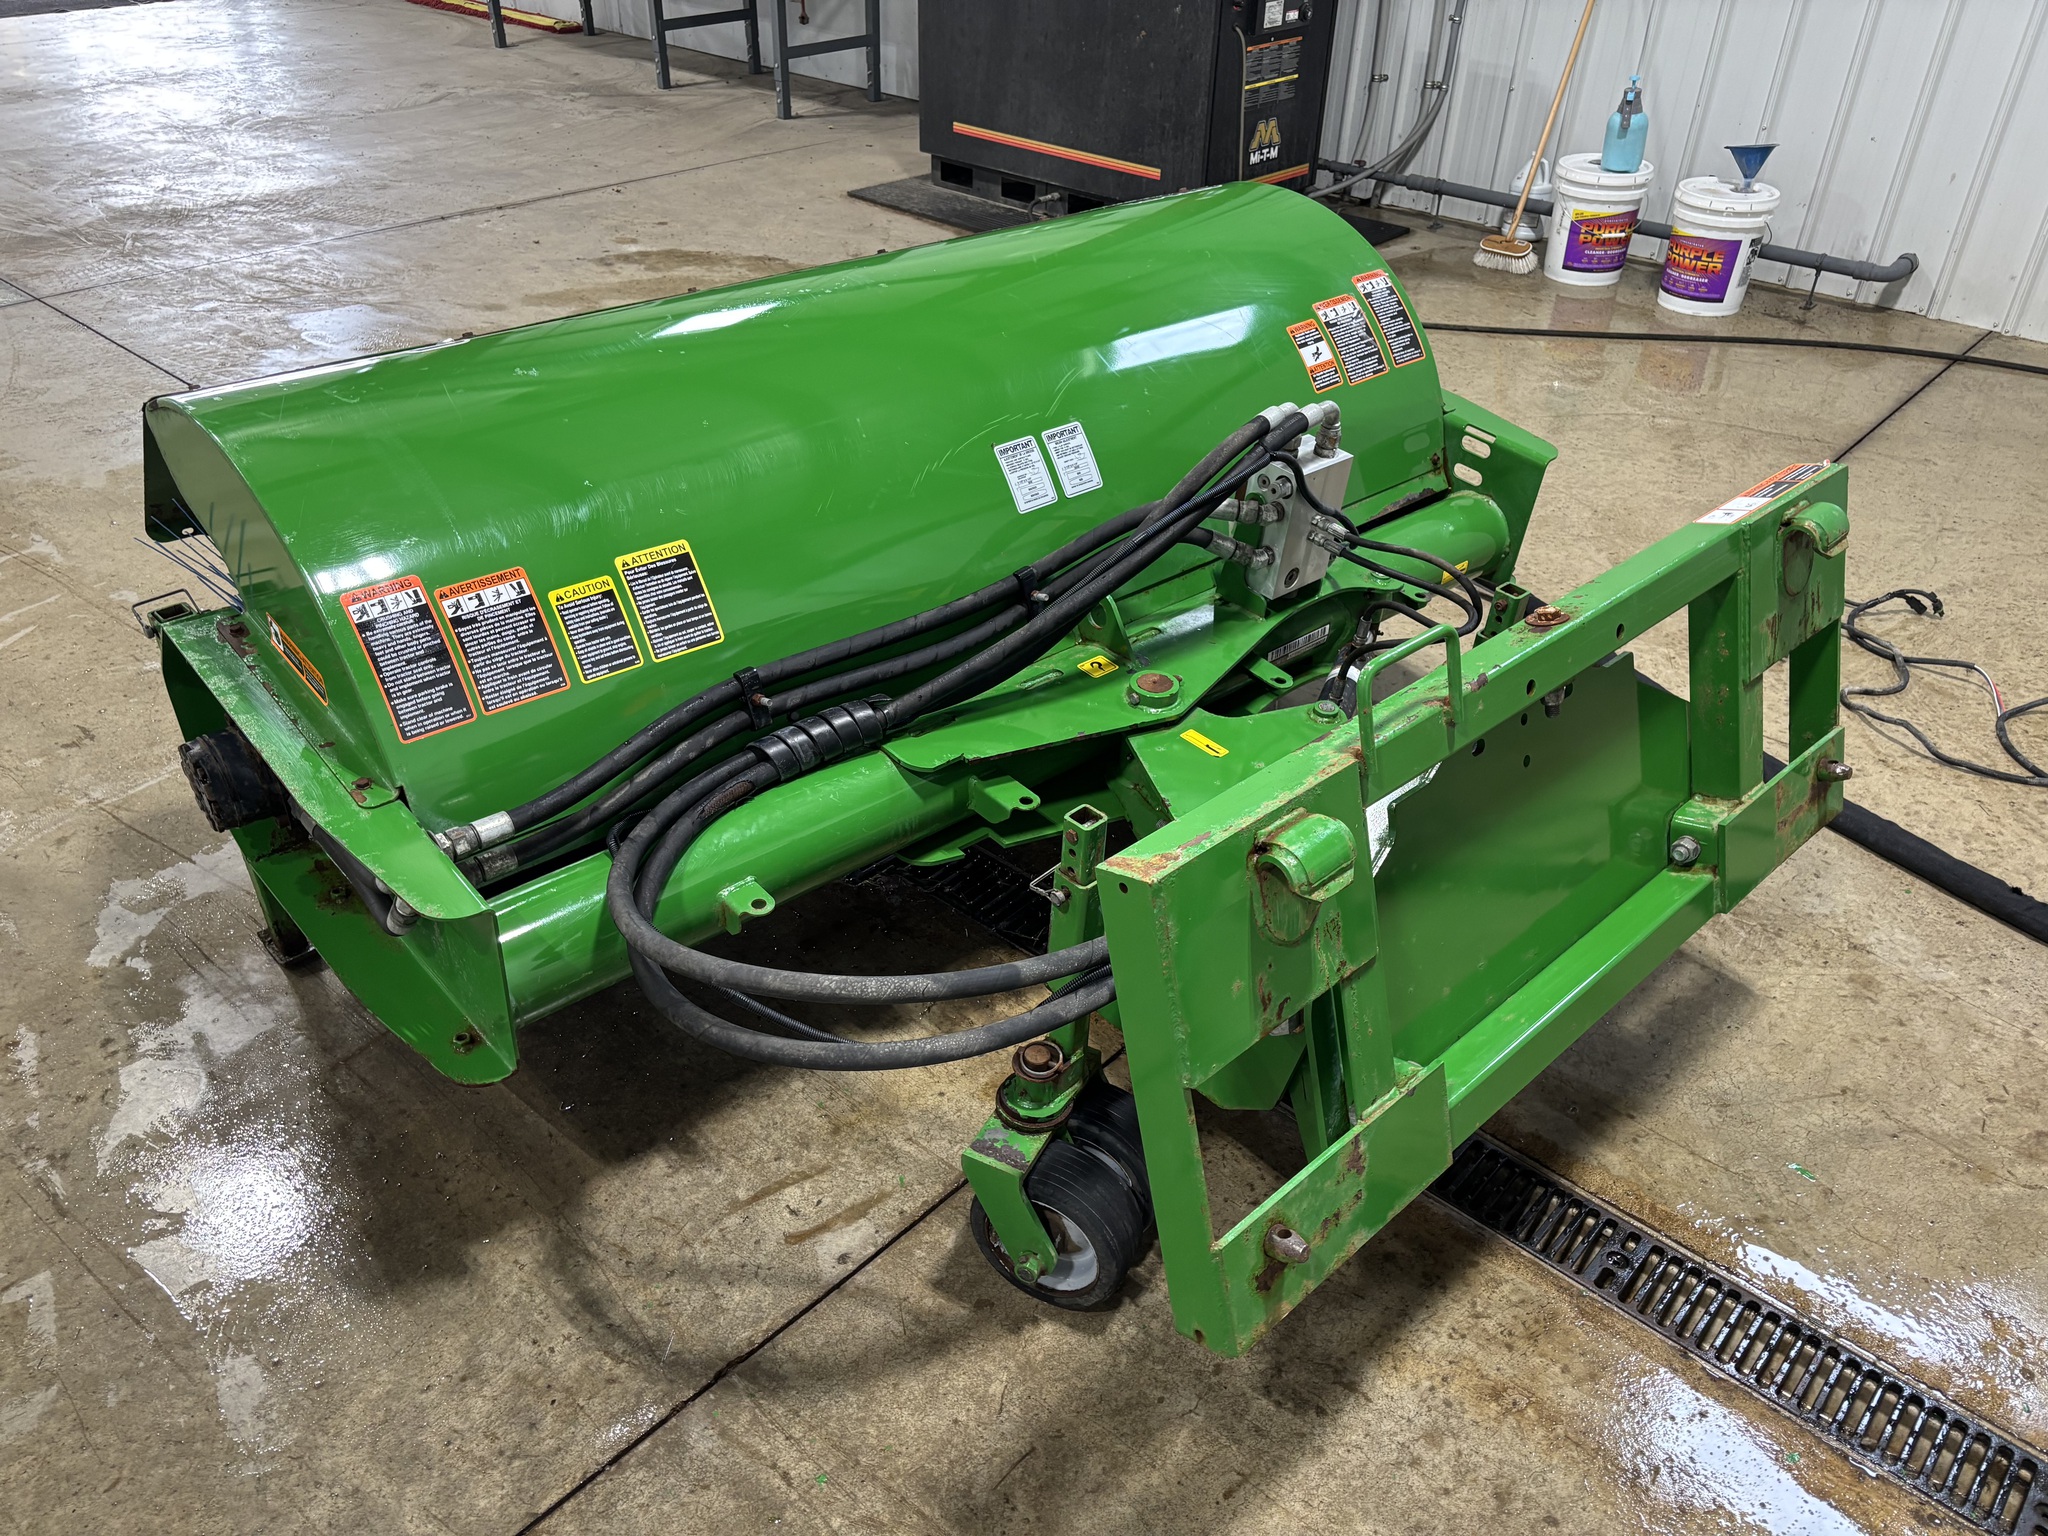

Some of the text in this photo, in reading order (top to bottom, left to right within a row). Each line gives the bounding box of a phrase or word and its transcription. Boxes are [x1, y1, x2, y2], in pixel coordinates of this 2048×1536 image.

[1250, 146, 1278, 165] Mi-T-M
[1580, 222, 1635, 236] PURPL
[1669, 239, 1726, 262] PURPLE
[1667, 250, 1723, 275] POWER
[1046, 426, 1079, 442] IMPORTANT
[998, 440, 1034, 456] IMPORTANT
[632, 544, 685, 564] ATTENTION
[361, 579, 412, 599] WARNING
[450, 569, 520, 595] AVERTISSEMENT
[564, 580, 610, 598] CAUTION
